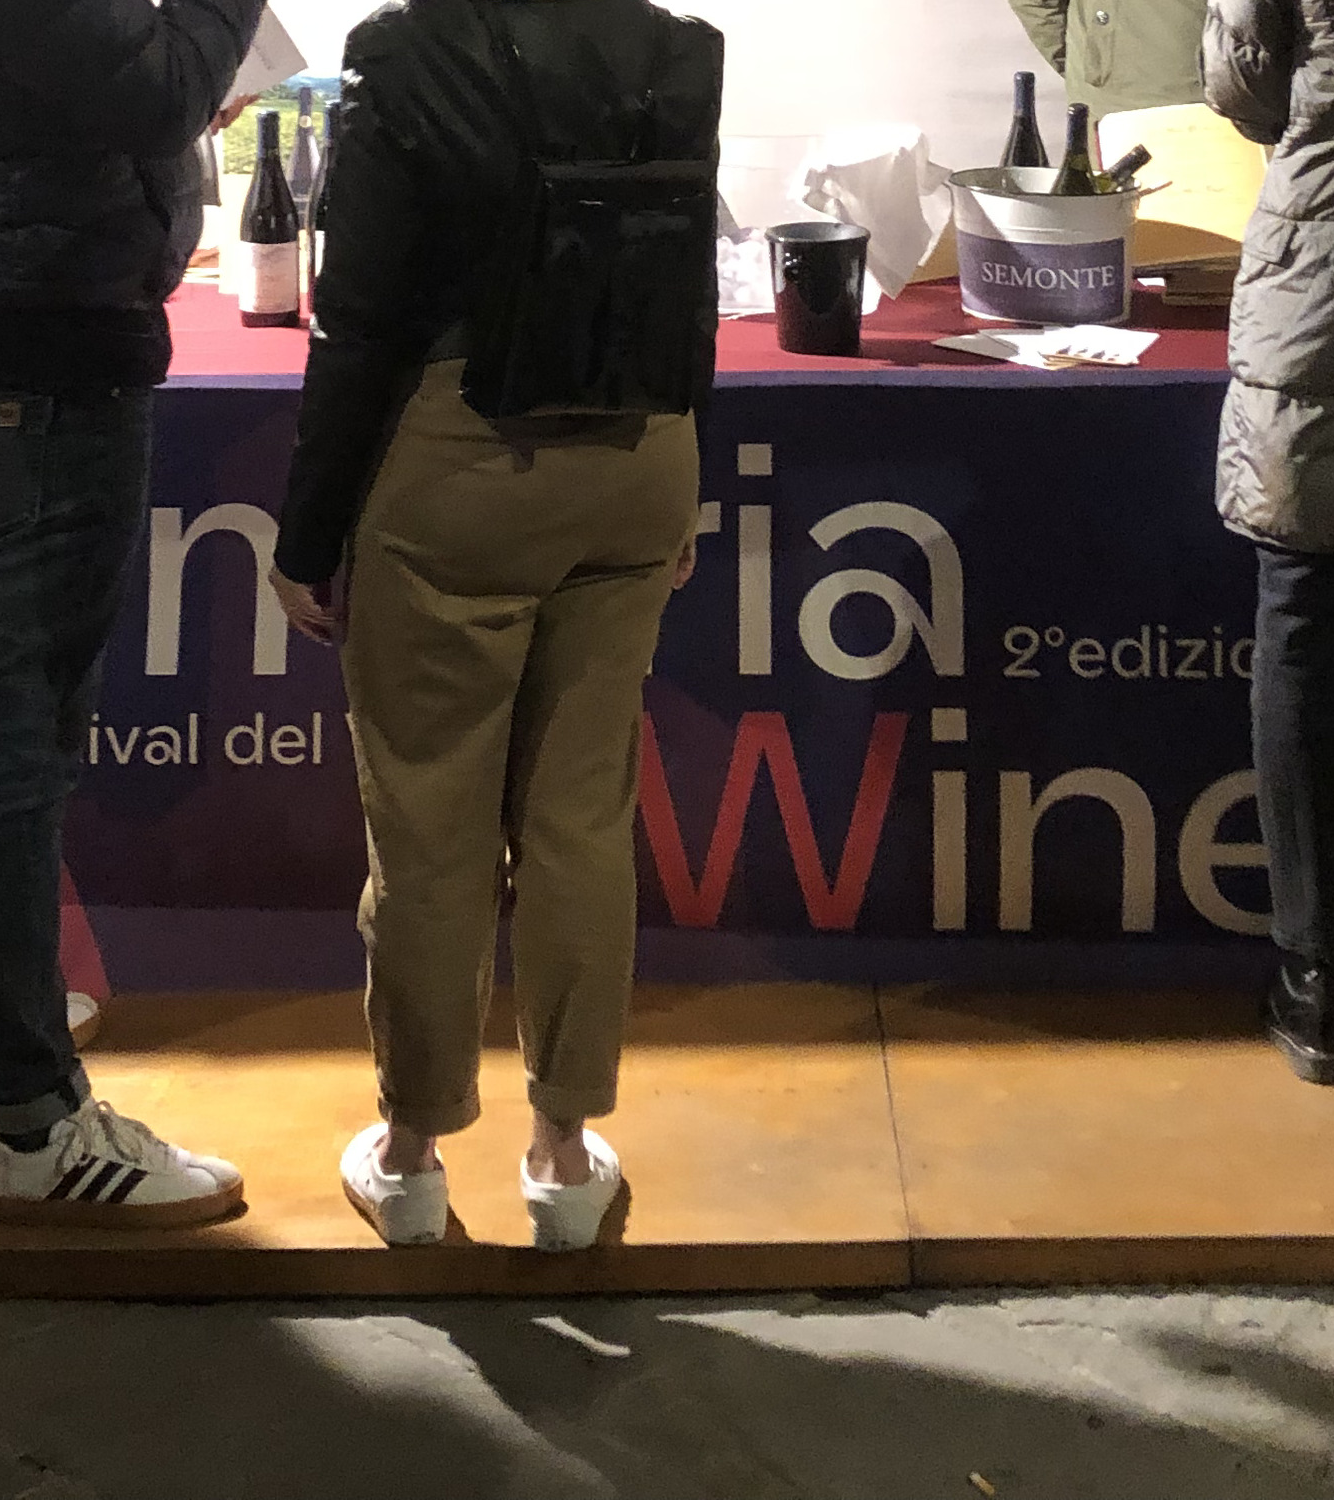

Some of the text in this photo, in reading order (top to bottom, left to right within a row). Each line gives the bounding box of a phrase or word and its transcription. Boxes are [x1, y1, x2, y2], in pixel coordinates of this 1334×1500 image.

[981, 261, 1115, 290] SEMONTE
[87, 710, 323, 765] ival del
